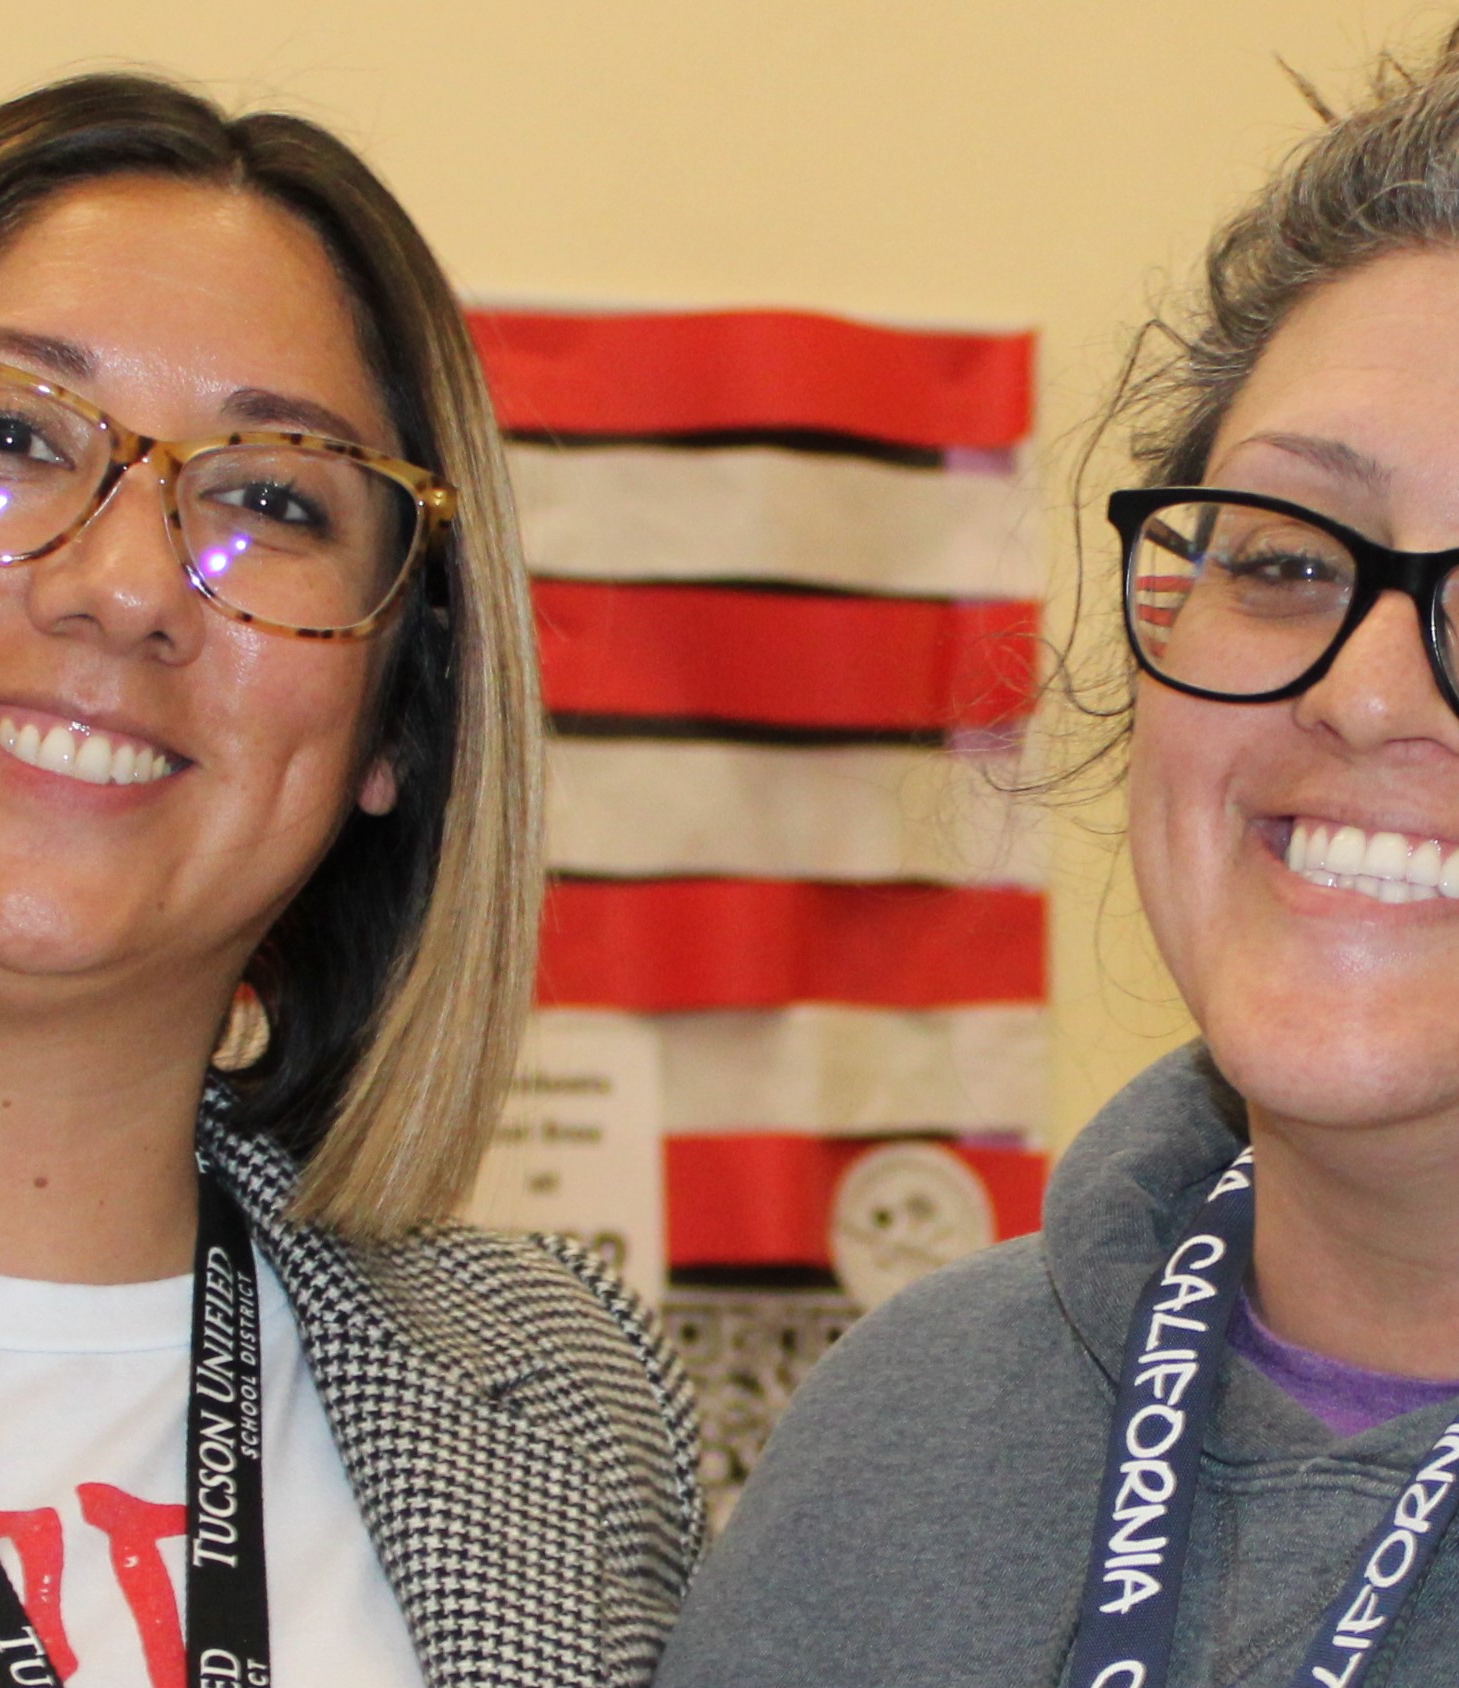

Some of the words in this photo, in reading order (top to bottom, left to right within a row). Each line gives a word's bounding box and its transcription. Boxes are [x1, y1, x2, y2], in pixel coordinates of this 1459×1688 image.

[196, 1246, 236, 1403] UNIFIED
[237, 1271, 257, 1367] DISTRICT
[193, 1408, 238, 1568] TUCSON
[240, 1375, 258, 1460] SCHOOL
[1098, 1234, 1227, 1615] CALIFORNIA
